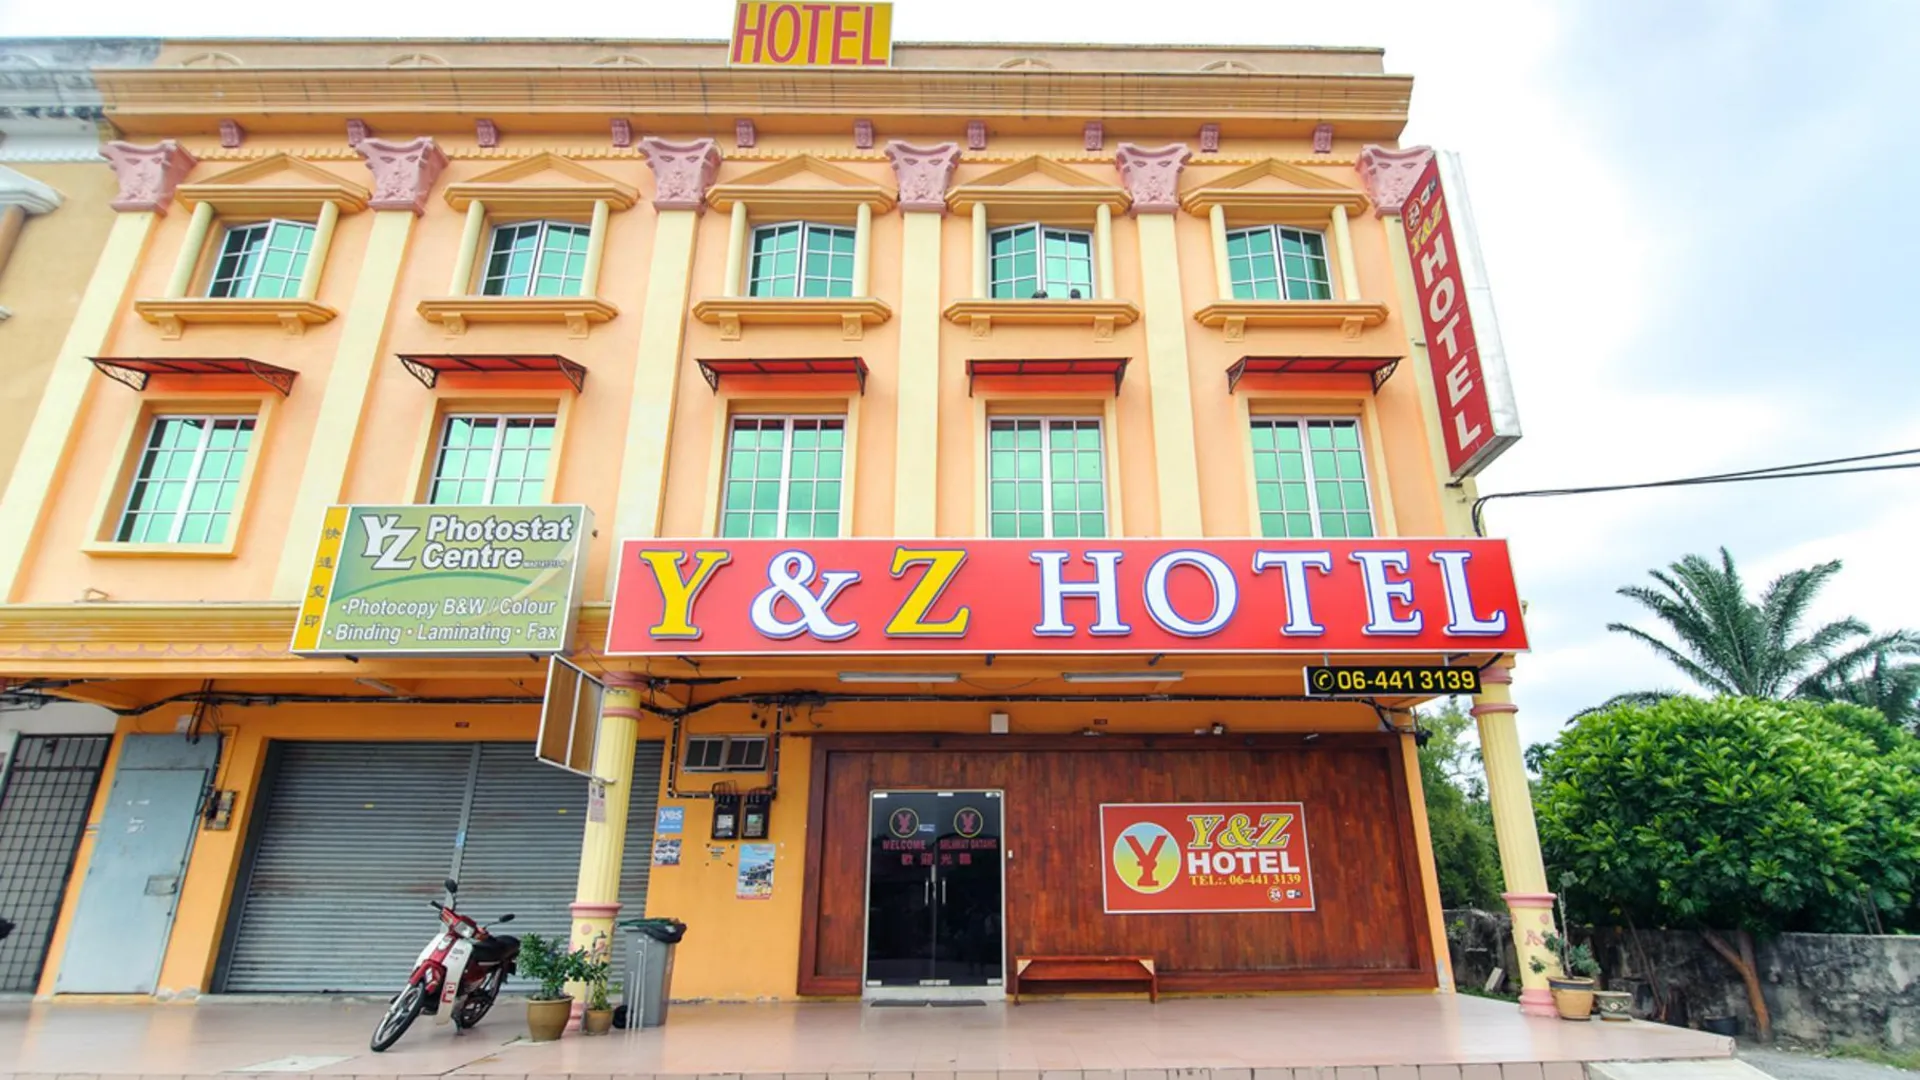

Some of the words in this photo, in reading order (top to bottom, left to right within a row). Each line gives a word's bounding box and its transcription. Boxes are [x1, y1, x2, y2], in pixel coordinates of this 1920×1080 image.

[733, 3, 886, 65] HOTEL
[1421, 233, 1481, 450] HOTEL
[360, 514, 420, 569] YZ
[427, 514, 573, 542] Photostat
[422, 542, 524, 569] Centre
[1029, 548, 1507, 637] HOTEL
[347, 598, 438, 619] Photocopy
[443, 598, 486, 615] B&W
[499, 598, 557, 615] Colour
[335, 623, 402, 643] Binding
[417, 622, 512, 645] Laminating
[526, 622, 558, 640] Fax
[1337, 671, 1404, 689] 06-441
[1420, 671, 1475, 689] 3139
[1187, 814, 1293, 849] Y&Z
[883, 840, 926, 850] WELCOME
[1187, 851, 1300, 874] HOTEL
[1229, 874, 1268, 885] 06-441
[1272, 873, 1302, 885] 3139
